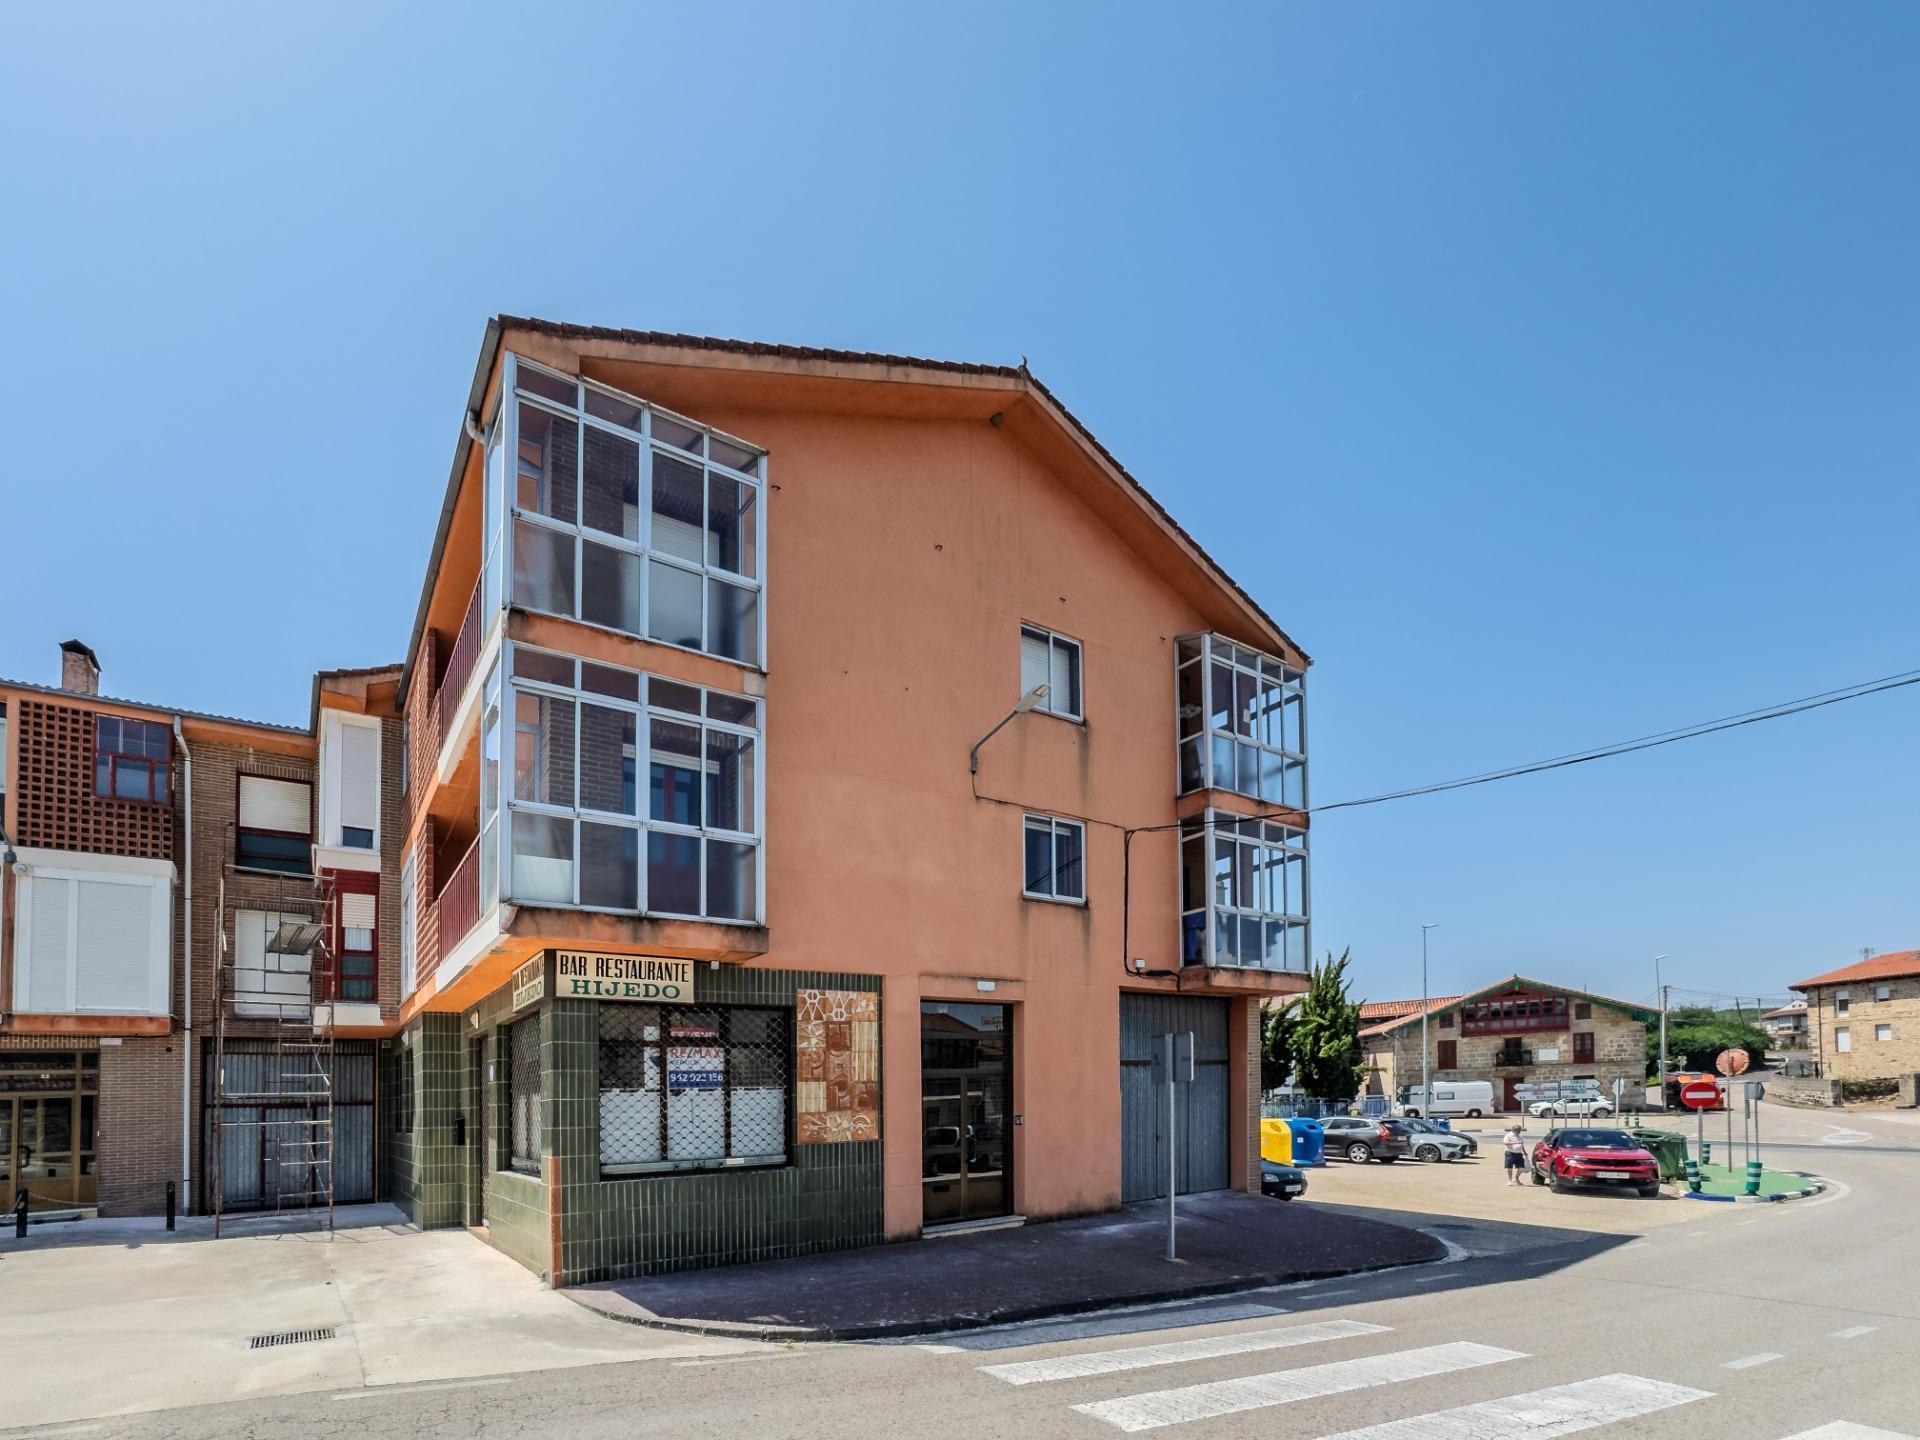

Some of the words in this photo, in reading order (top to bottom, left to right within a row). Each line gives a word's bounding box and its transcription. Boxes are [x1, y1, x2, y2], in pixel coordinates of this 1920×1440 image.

[560, 954, 587, 976] BAR
[596, 957, 690, 982] RESTAURANTE
[571, 979, 681, 999] HIJEDO
[670, 1047, 720, 1058] RE/MAX
